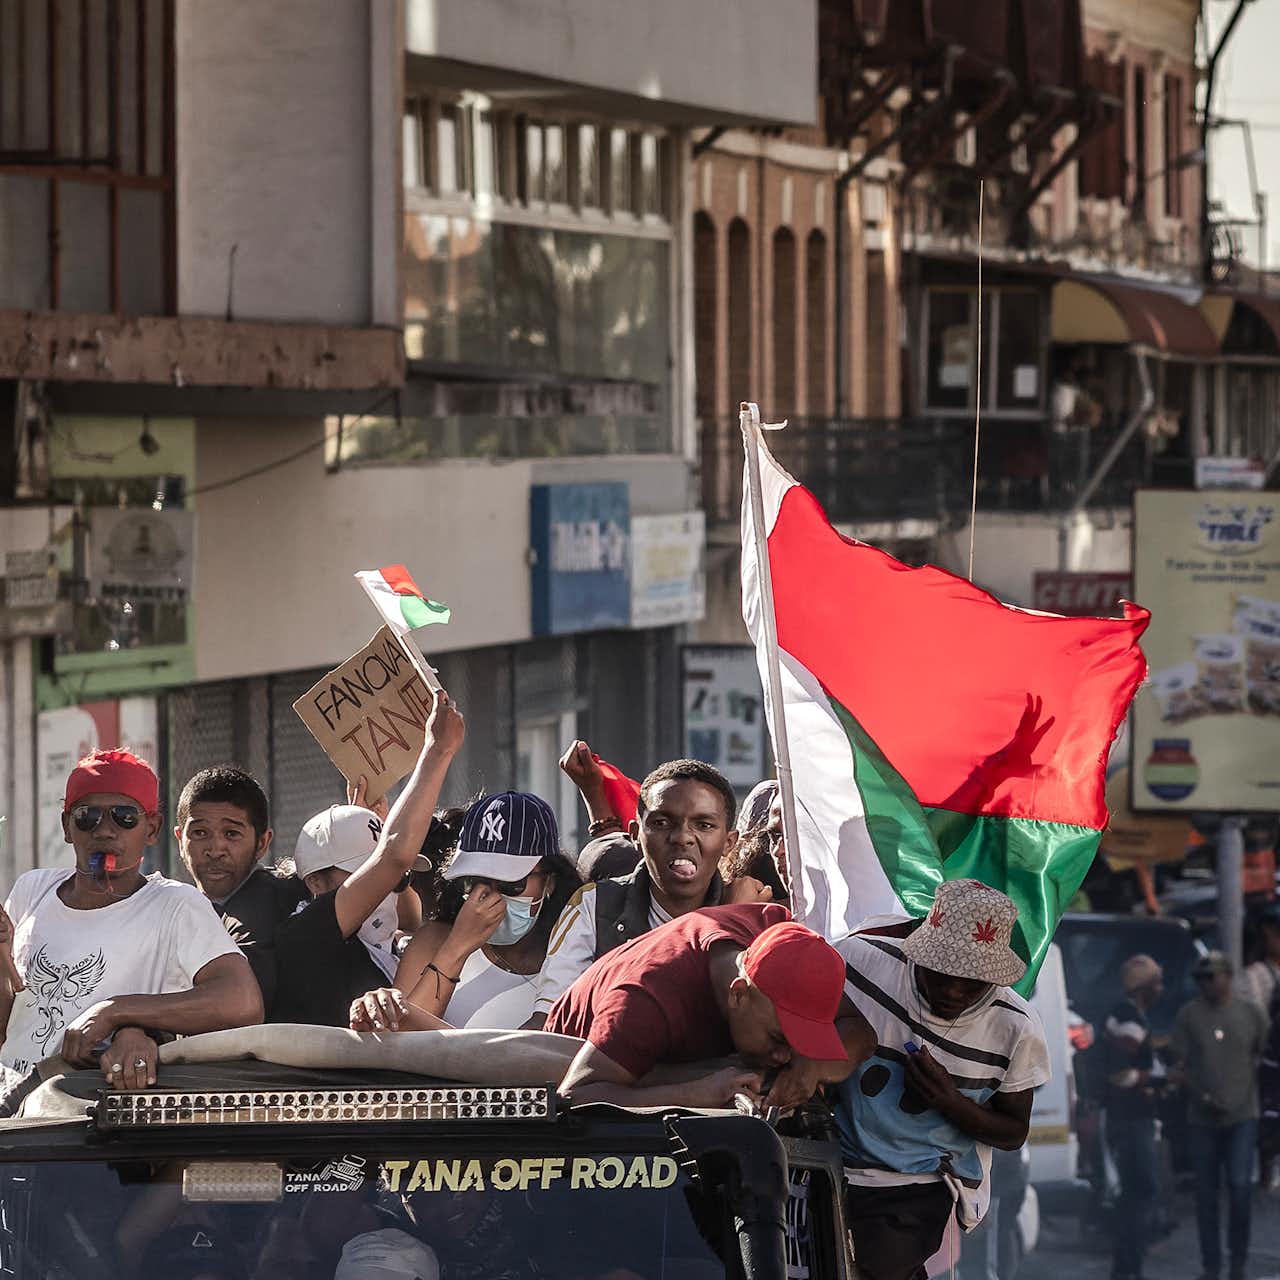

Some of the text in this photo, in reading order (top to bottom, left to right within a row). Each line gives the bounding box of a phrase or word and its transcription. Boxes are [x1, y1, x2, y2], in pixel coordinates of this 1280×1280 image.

[479, 812, 506, 842] NY
[286, 1173, 321, 1182] TANA
[385, 1156, 678, 1192] TANA OFF ROAD
[285, 1183, 349, 1192] OFF ROAD
